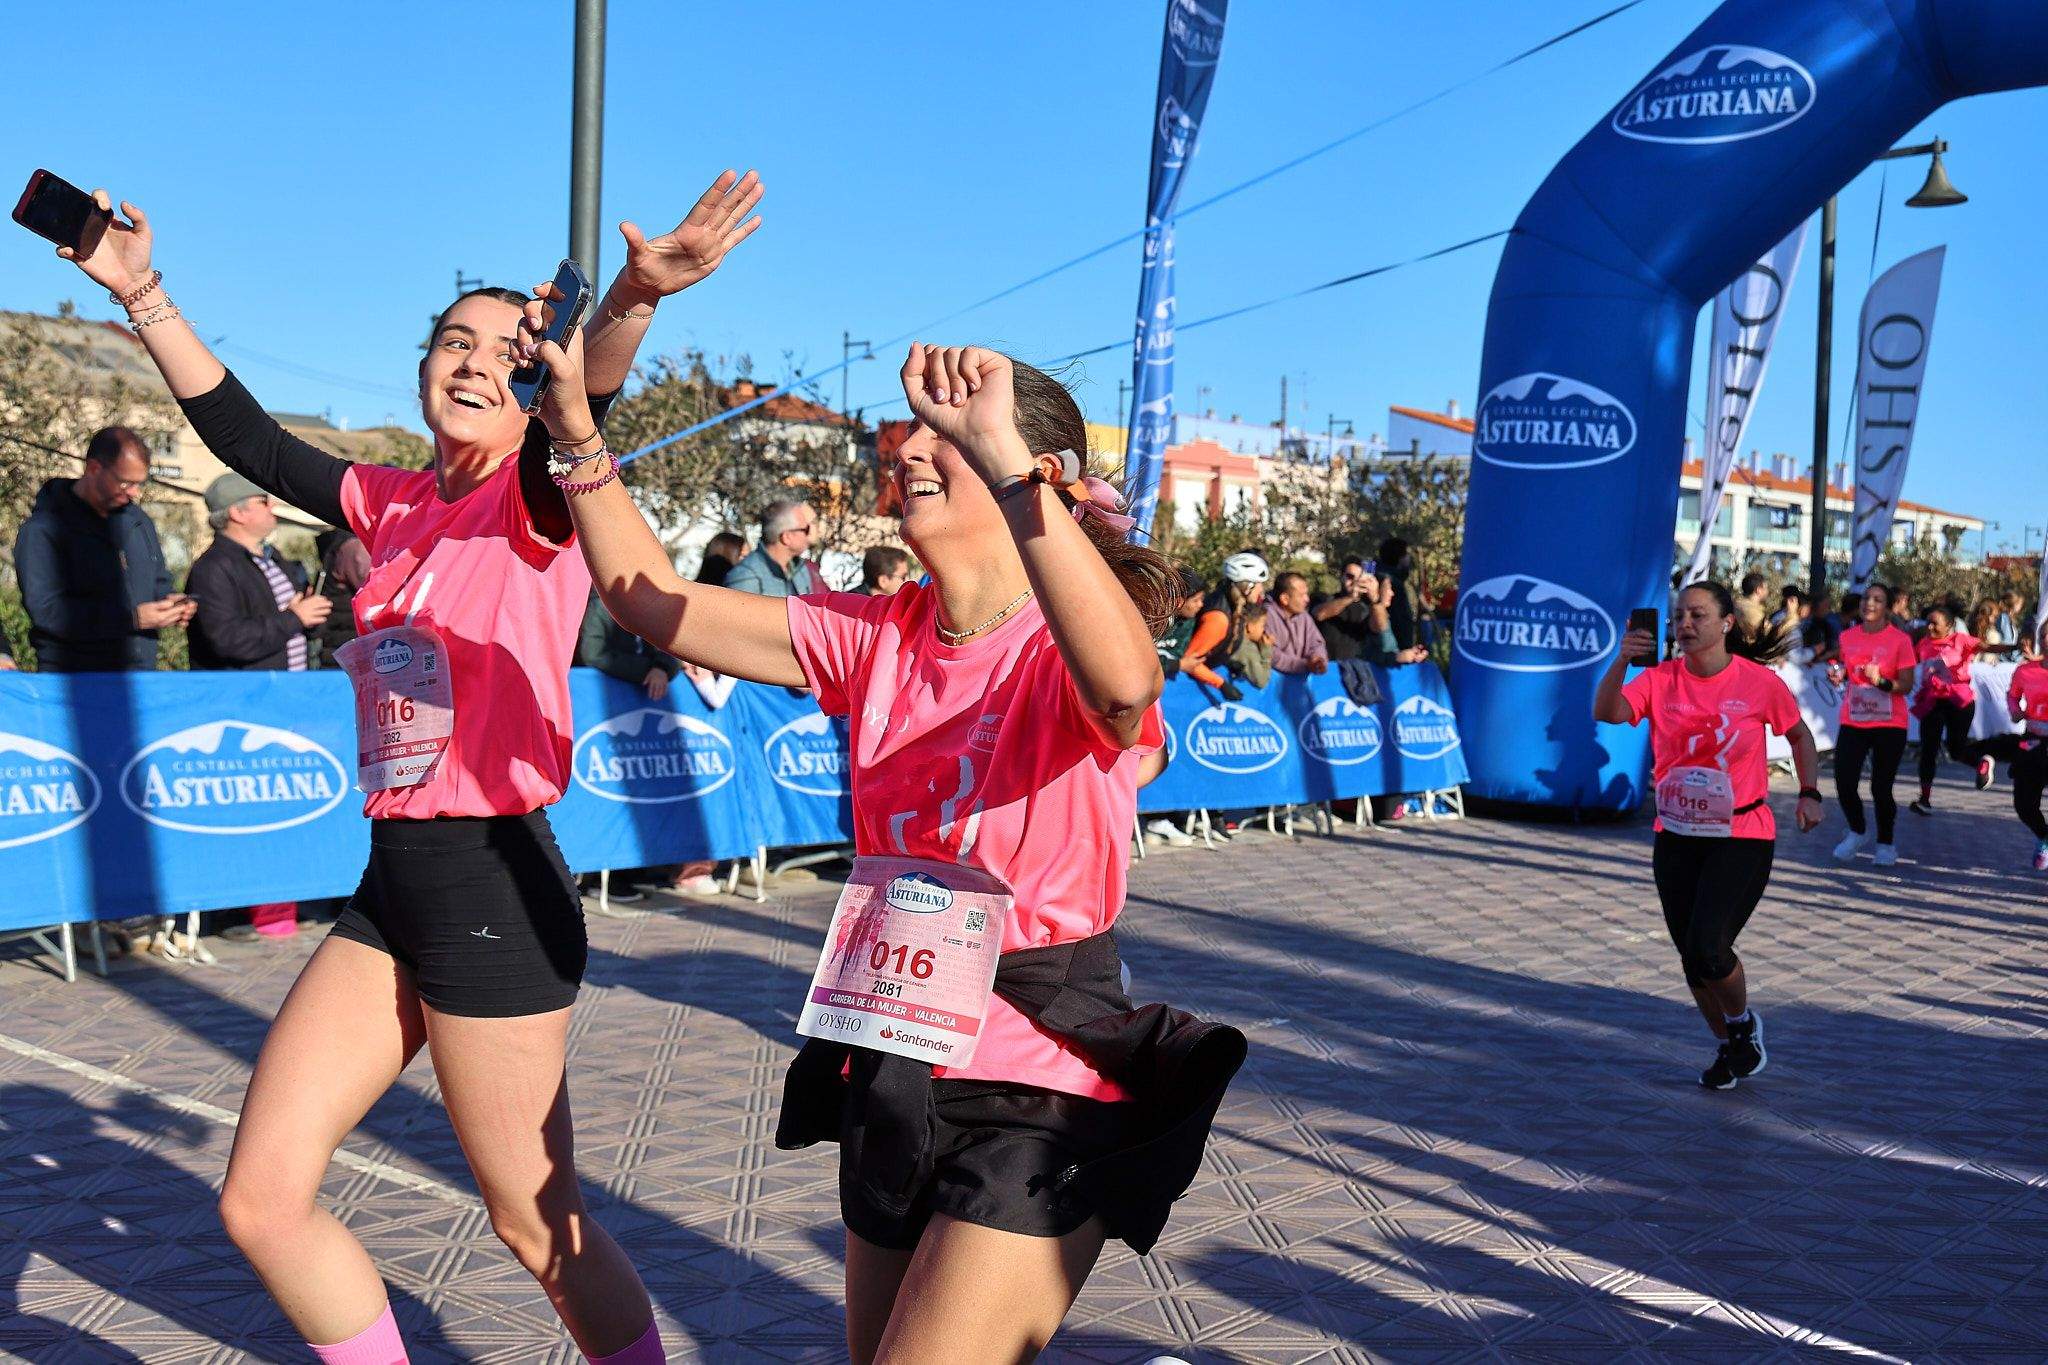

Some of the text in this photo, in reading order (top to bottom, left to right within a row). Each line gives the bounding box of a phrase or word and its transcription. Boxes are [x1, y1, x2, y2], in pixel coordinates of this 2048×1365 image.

[1721, 72, 1792, 86] LECHERA
[1623, 86, 1798, 126] ASTURIANA
[1480, 409, 1620, 449] ASTURIANA
[1856, 313, 1924, 584] OYSHO
[1458, 606, 1600, 653] ASTURIANA
[377, 697, 415, 727] 016
[1195, 728, 1280, 755] ASTURIANA
[1308, 724, 1379, 749] ASTURIANA
[1397, 719, 1457, 744] ASTURIANA
[411, 742, 438, 753] VALENCIA
[586, 744, 728, 782] ASTURIANA
[142, 763, 335, 808] ASTURIANA
[1678, 796, 1709, 811] 016
[887, 883, 946, 907] ASTURIANA
[870, 940, 936, 980] 016
[872, 980, 902, 998] 2081
[819, 1012, 862, 1032] OYSHO
[829, 993, 855, 1007] CARRERA
[856, 997, 866, 1008] DE
[867, 998, 876, 1009] LA
[877, 1000, 907, 1017] MUJER
[915, 1008, 957, 1027] VALENCIA
[895, 1030, 954, 1054] Santander
